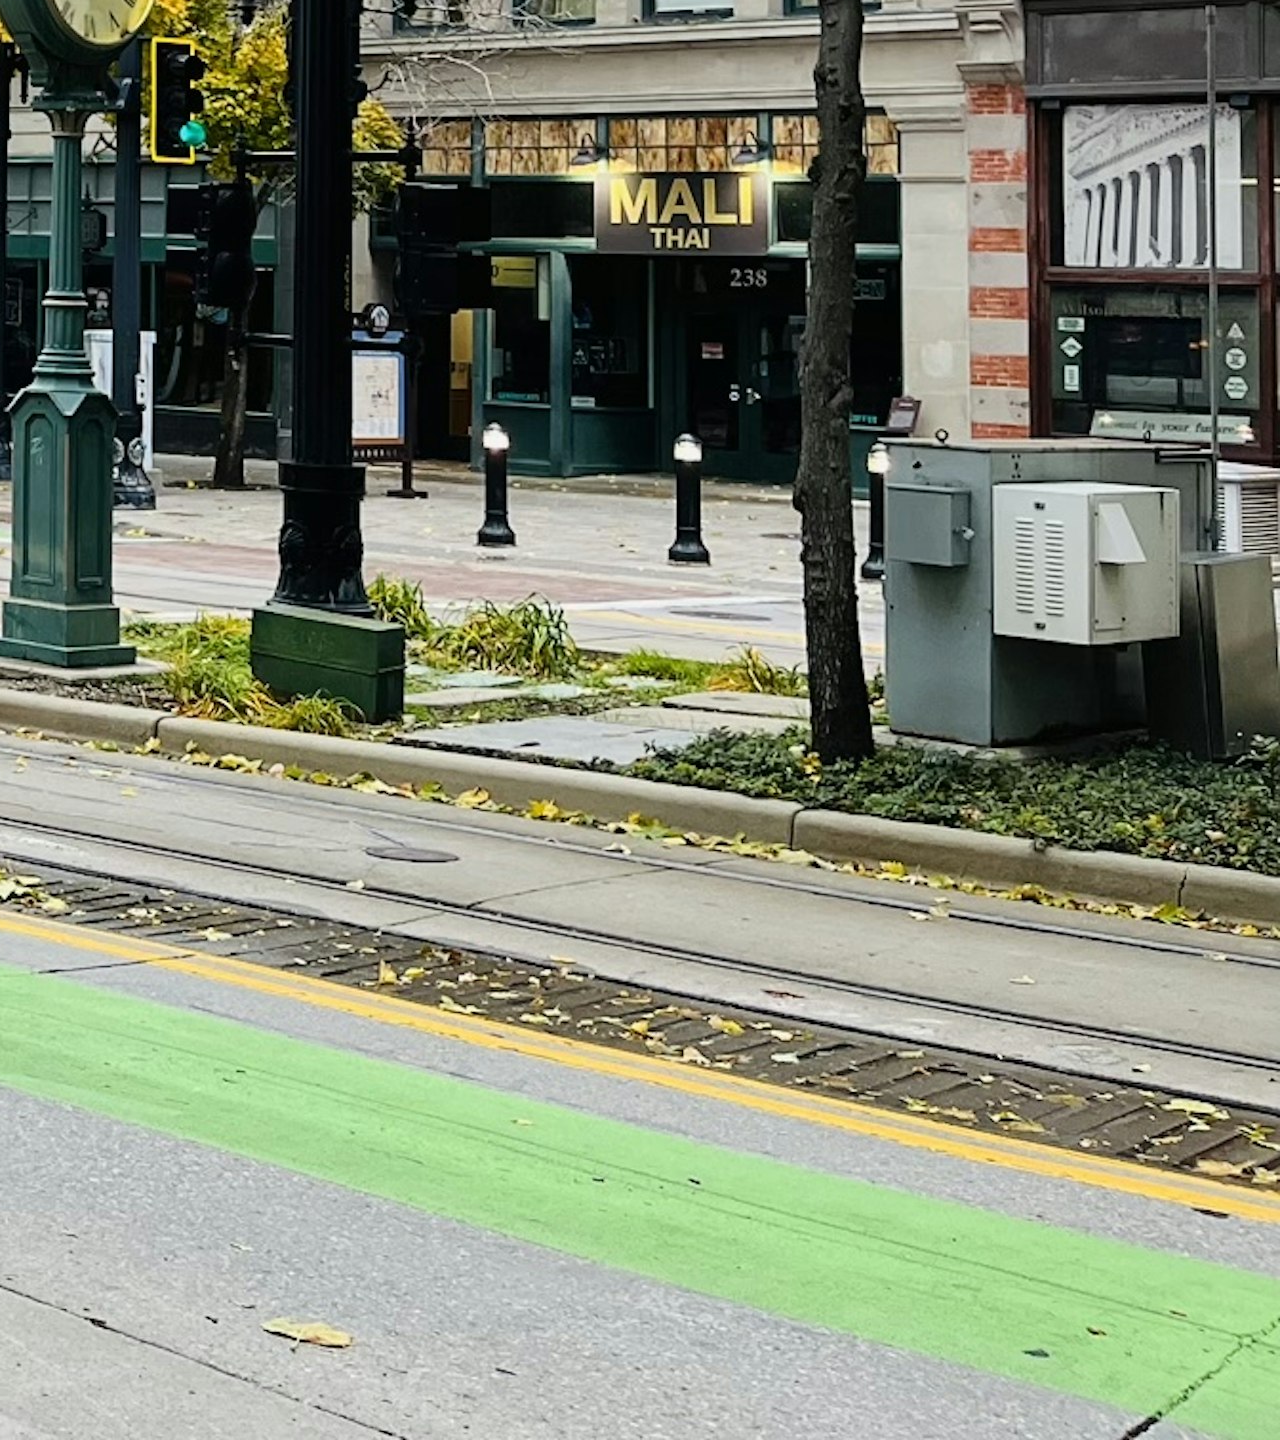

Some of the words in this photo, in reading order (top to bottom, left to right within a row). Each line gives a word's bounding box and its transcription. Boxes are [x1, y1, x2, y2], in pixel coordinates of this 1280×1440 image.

[610, 177, 754, 225] MALI
[649, 227, 710, 249] THAI
[730, 268, 768, 287] 238
[1162, 423, 1189, 433] your
